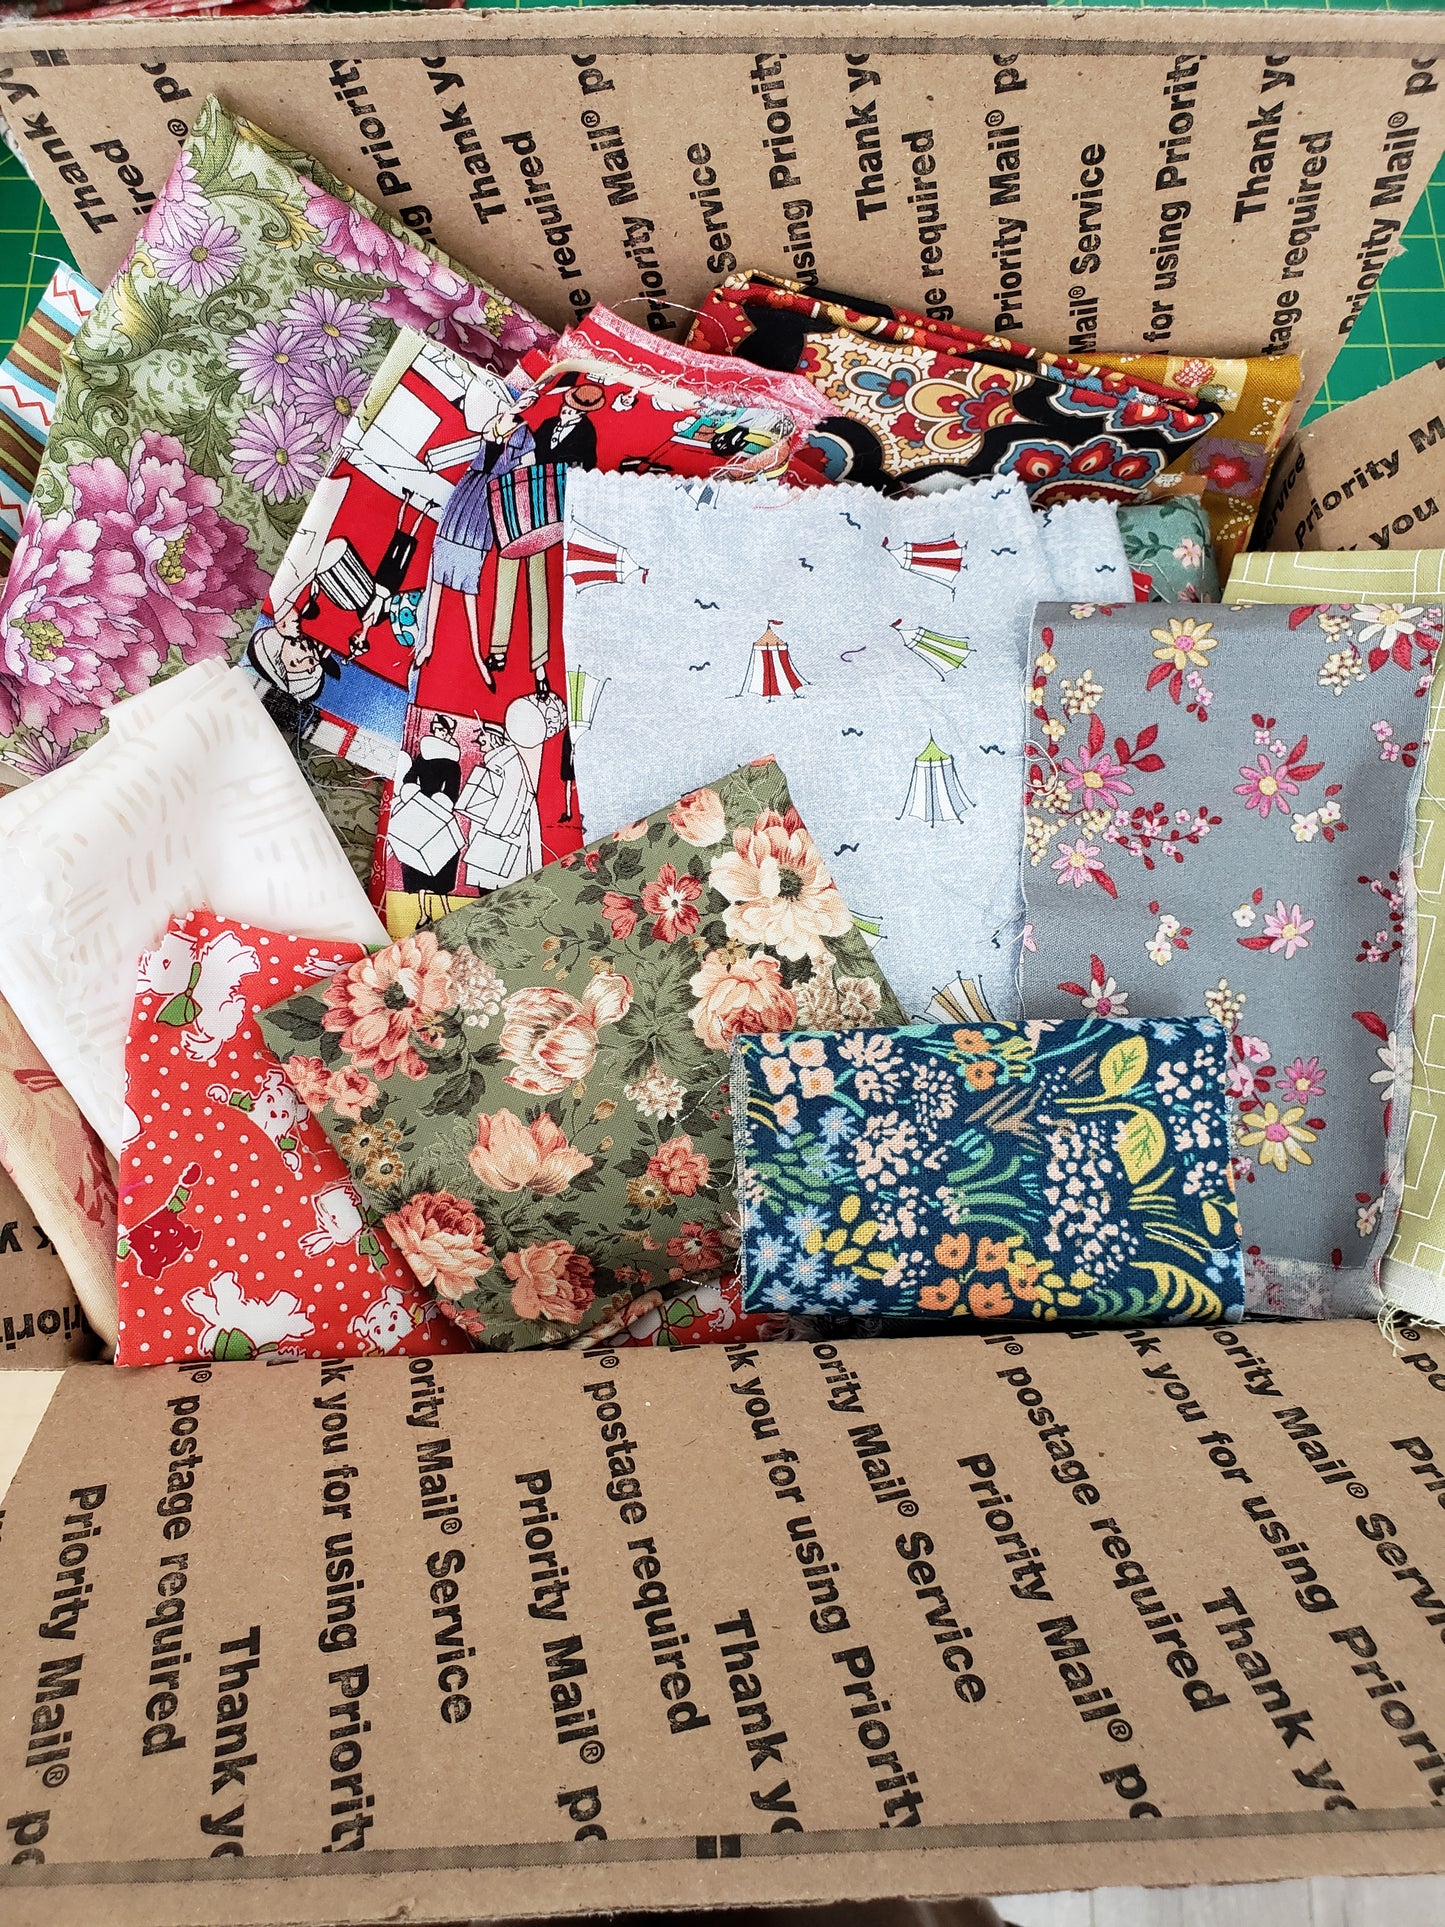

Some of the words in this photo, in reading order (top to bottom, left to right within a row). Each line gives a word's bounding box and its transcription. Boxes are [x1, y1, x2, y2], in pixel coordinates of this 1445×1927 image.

[23, 111, 118, 234] Thank
[90, 139, 157, 215] ired
[440, 101, 507, 224] Thank
[501, 131, 582, 279] required
[686, 142, 737, 274] Service
[846, 100, 887, 221] Thank
[902, 129, 947, 278] required
[1070, 143, 1106, 275] Service
[1233, 99, 1284, 223] Thank
[1281, 130, 1334, 280] required
[622, 216, 677, 332] Priority
[783, 199, 819, 286] using
[991, 217, 1028, 332] Priority
[1150, 198, 1192, 291] using
[1143, 300, 1174, 343] for
[1264, 452, 1306, 541] ervice
[1295, 449, 1399, 549] Priority
[1369, 497, 1440, 550] you
[157, 1394, 203, 1540] postage
[313, 1391, 348, 1455] you
[1142, 1362, 1208, 1422] you
[1197, 1430, 1253, 1484] for
[1242, 1496, 1339, 1613] using
[322, 1464, 359, 1520] for
[515, 1469, 569, 1622] Priority
[583, 1380, 648, 1525] postage
[627, 1536, 712, 1735] required
[730, 1376, 780, 1440] you
[761, 1448, 805, 1503] for
[786, 1515, 851, 1634] using
[957, 1452, 1053, 1602] Priority
[996, 1366, 1100, 1505] postage
[1090, 1517, 1231, 1713] required
[39, 1484, 108, 1640] Priority
[318, 1531, 364, 1653] using
[896, 1531, 987, 1704] Service
[142, 1553, 192, 1757] required
[425, 1549, 475, 1724] Service
[714, 1608, 789, 1772] Thank
[1203, 1586, 1315, 1749] Thank
[211, 1625, 261, 1795] Thank
